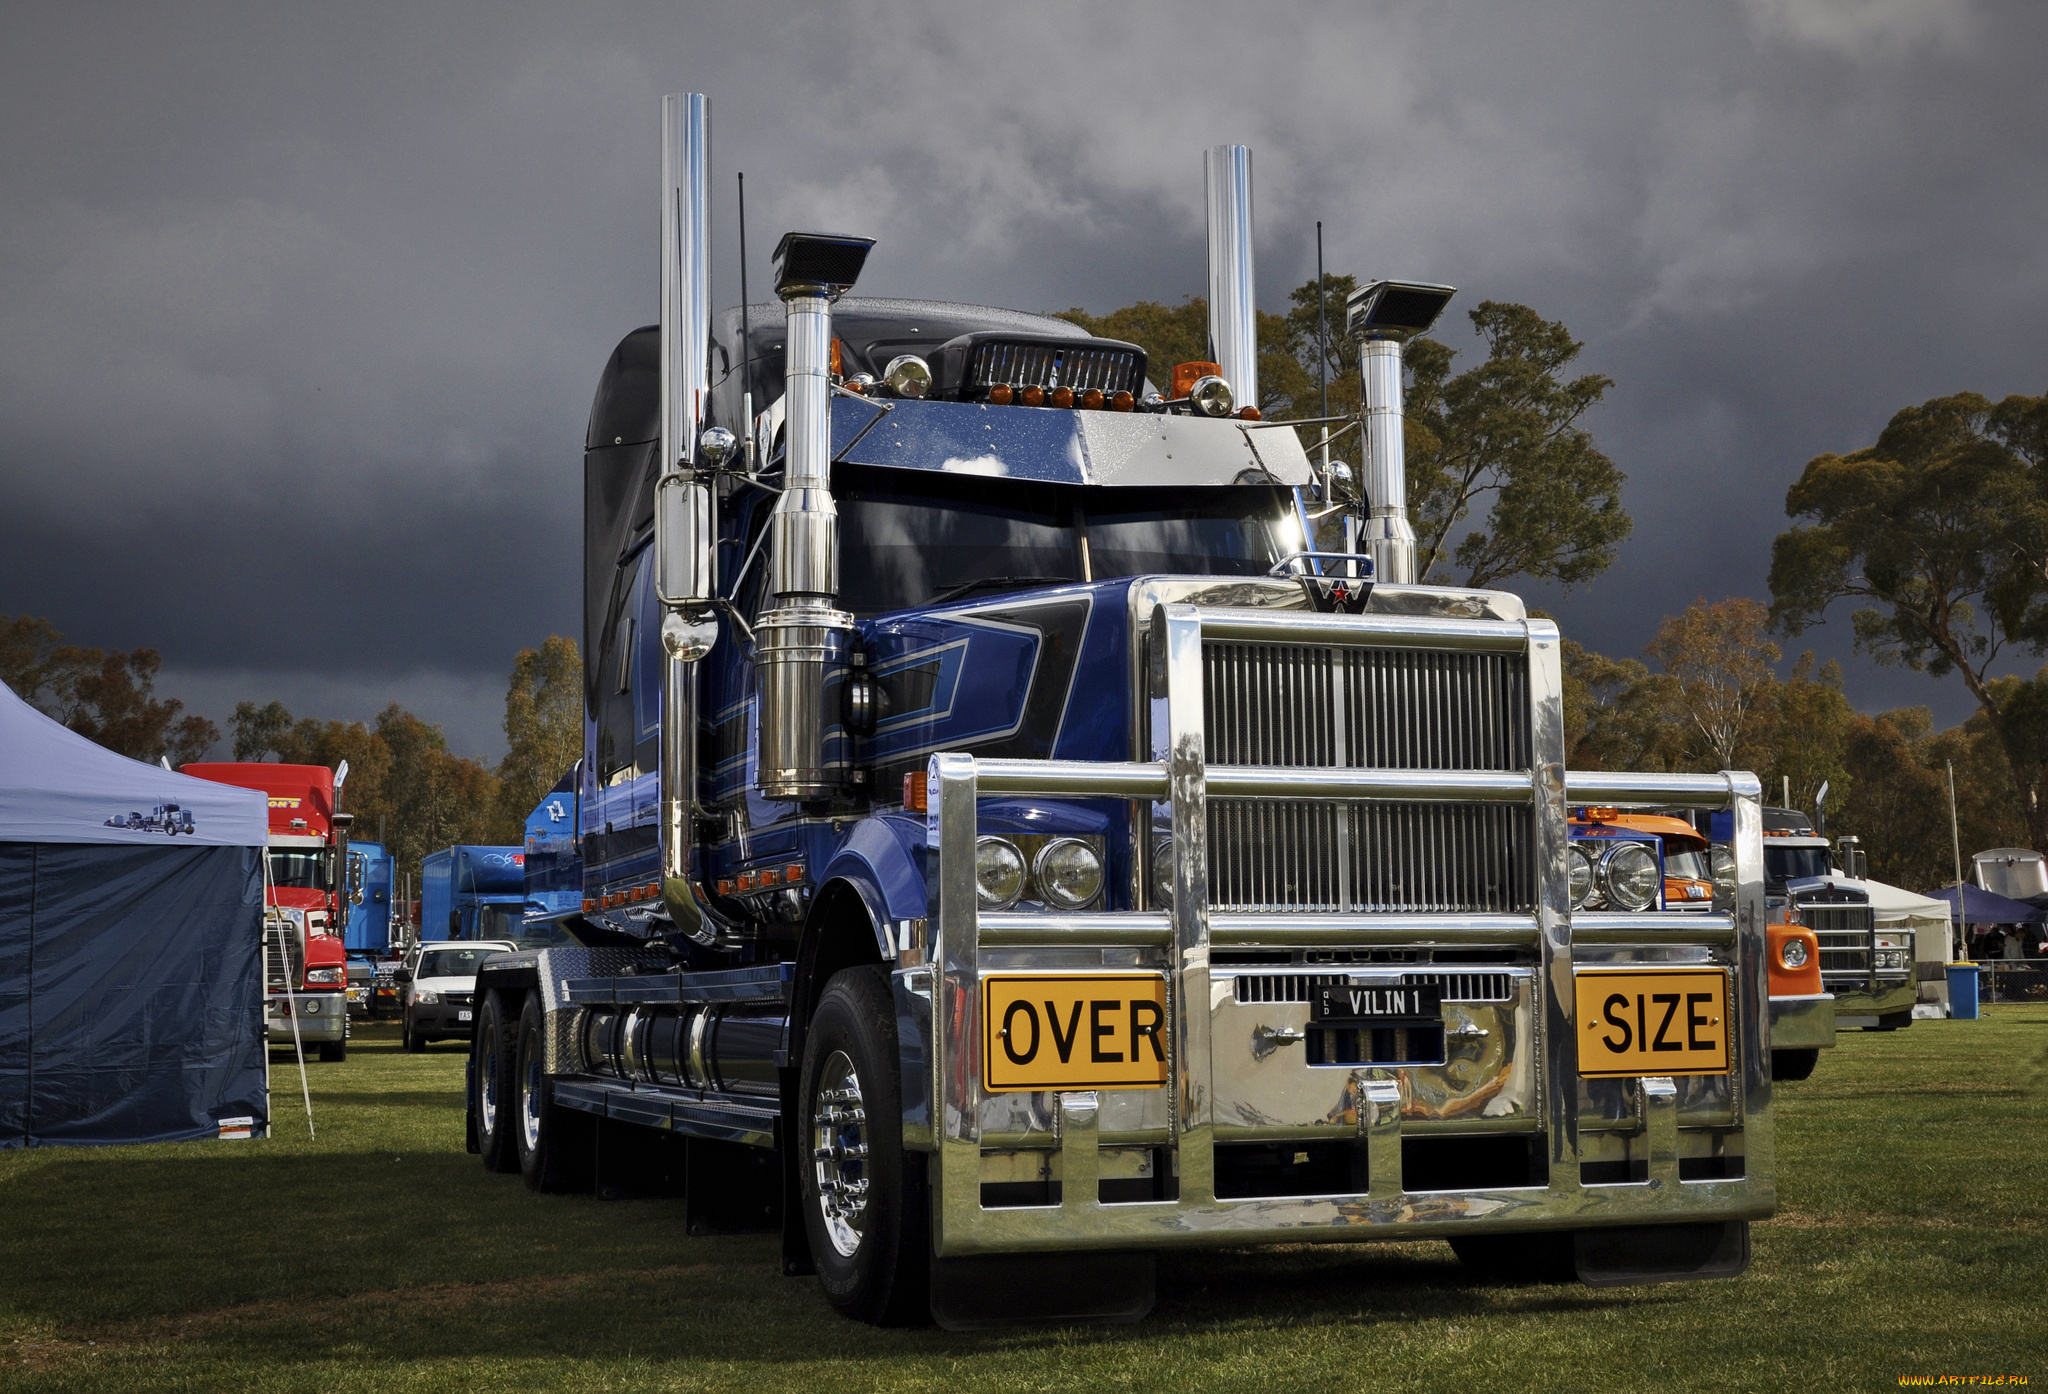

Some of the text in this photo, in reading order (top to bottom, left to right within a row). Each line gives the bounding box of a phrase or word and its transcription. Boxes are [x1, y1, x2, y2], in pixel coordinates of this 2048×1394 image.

[1003, 1000, 1166, 1065] OVER
[1349, 990, 1419, 1014] VILIN 1
[1602, 993, 1716, 1054] SIZE
